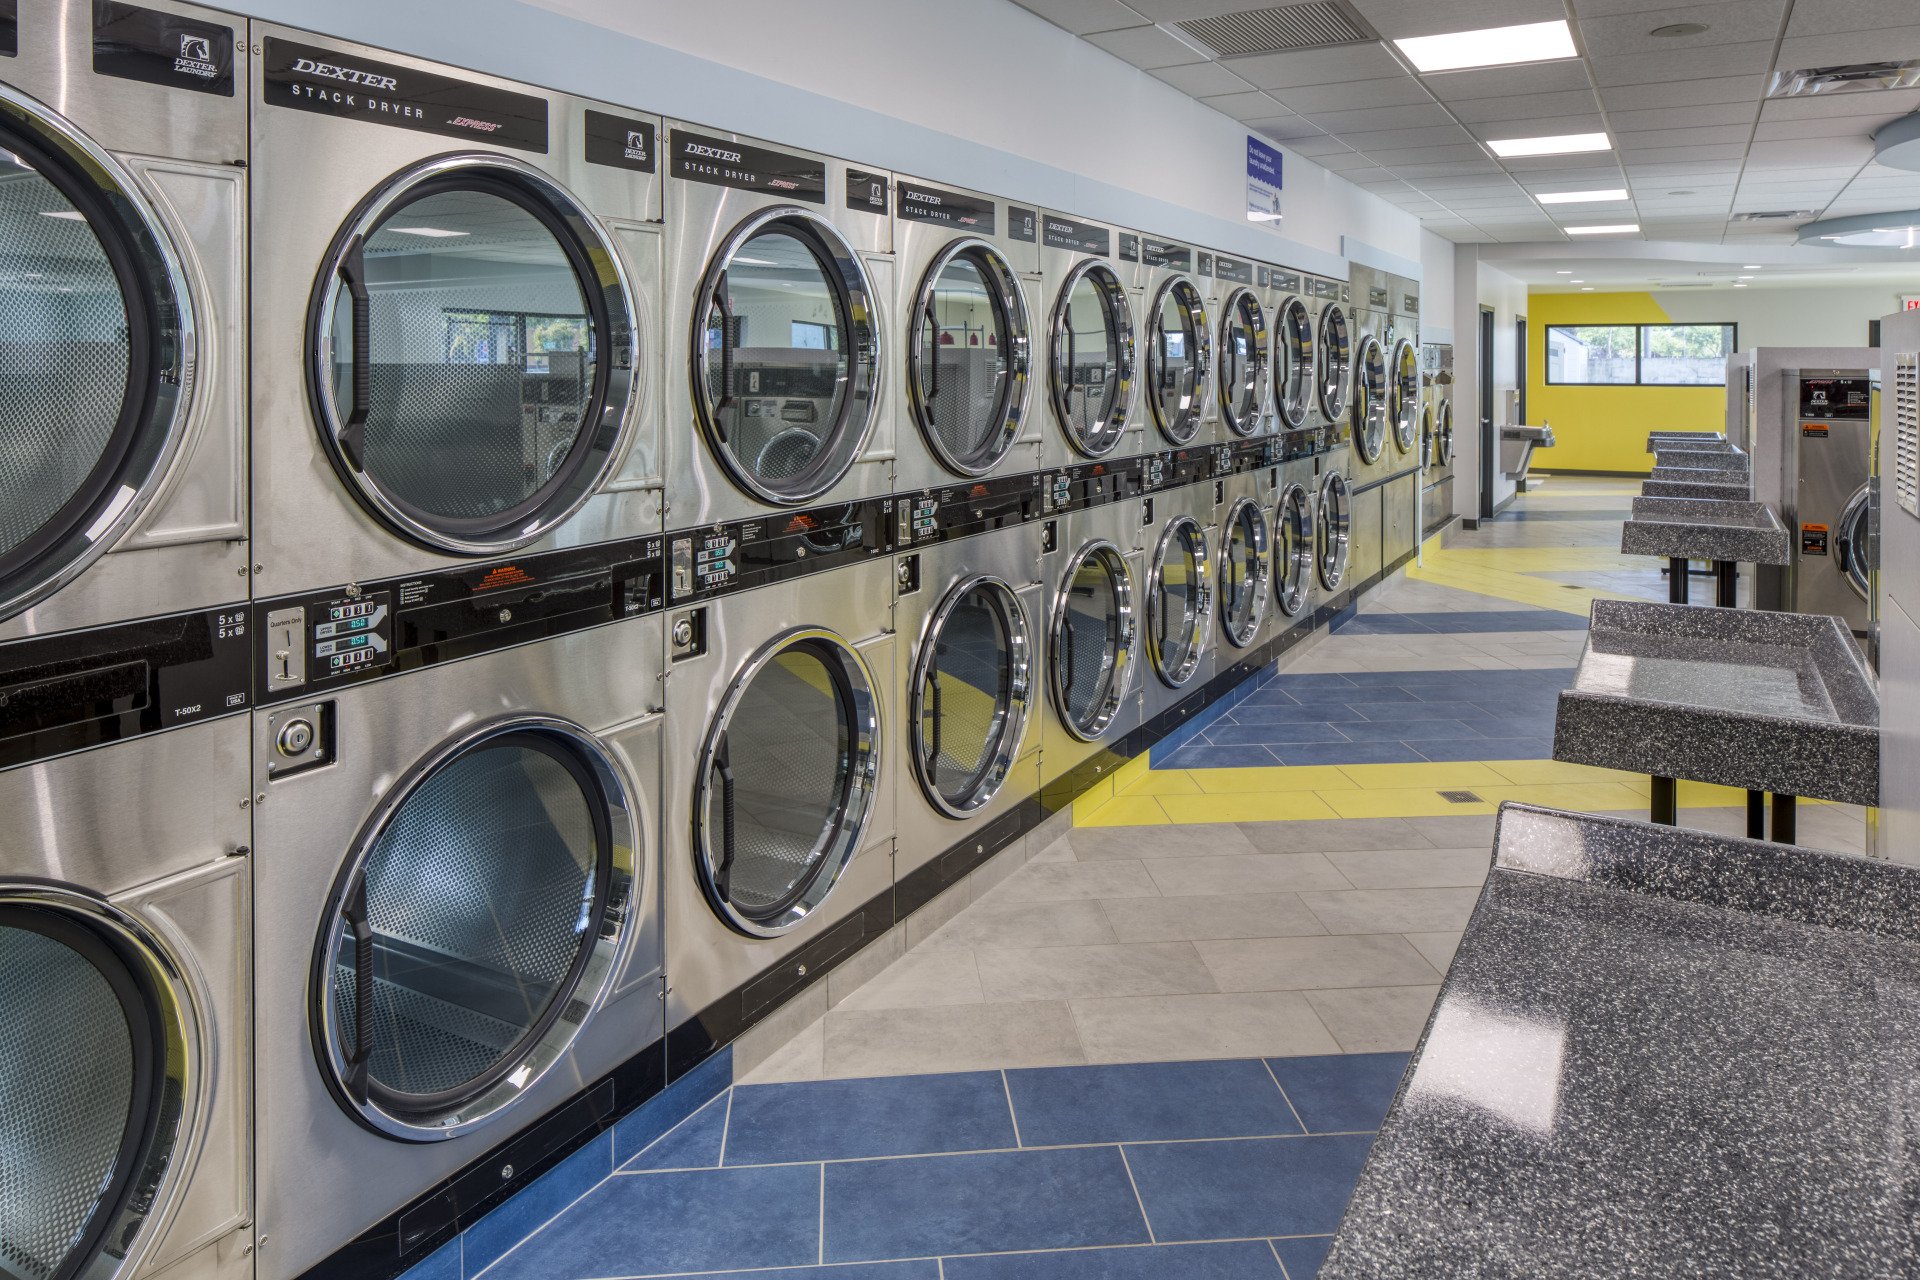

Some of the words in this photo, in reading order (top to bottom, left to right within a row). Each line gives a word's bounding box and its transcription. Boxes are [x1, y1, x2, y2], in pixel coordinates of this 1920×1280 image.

[174, 57, 214, 71] DEXTER
[174, 65, 217, 78] LAUNDRY
[292, 58, 397, 91] DEXTER
[292, 84, 355, 106] STACK
[368, 99, 424, 119] DRYER
[453, 116, 496, 132] EXPRESS
[685, 142, 742, 163] DEXTER
[684, 161, 719, 175] STACK
[725, 169, 756, 183] DRYER
[906, 190, 941, 205] DEXTER
[905, 205, 928, 216] STACK
[1049, 222, 1073, 234] DEXTER
[219, 615, 226, 625] 5
[270, 618, 291, 628] Quarters
[291, 617, 302, 626] Only
[219, 628, 226, 639] 5
[175, 704, 201, 717] T-50X2
